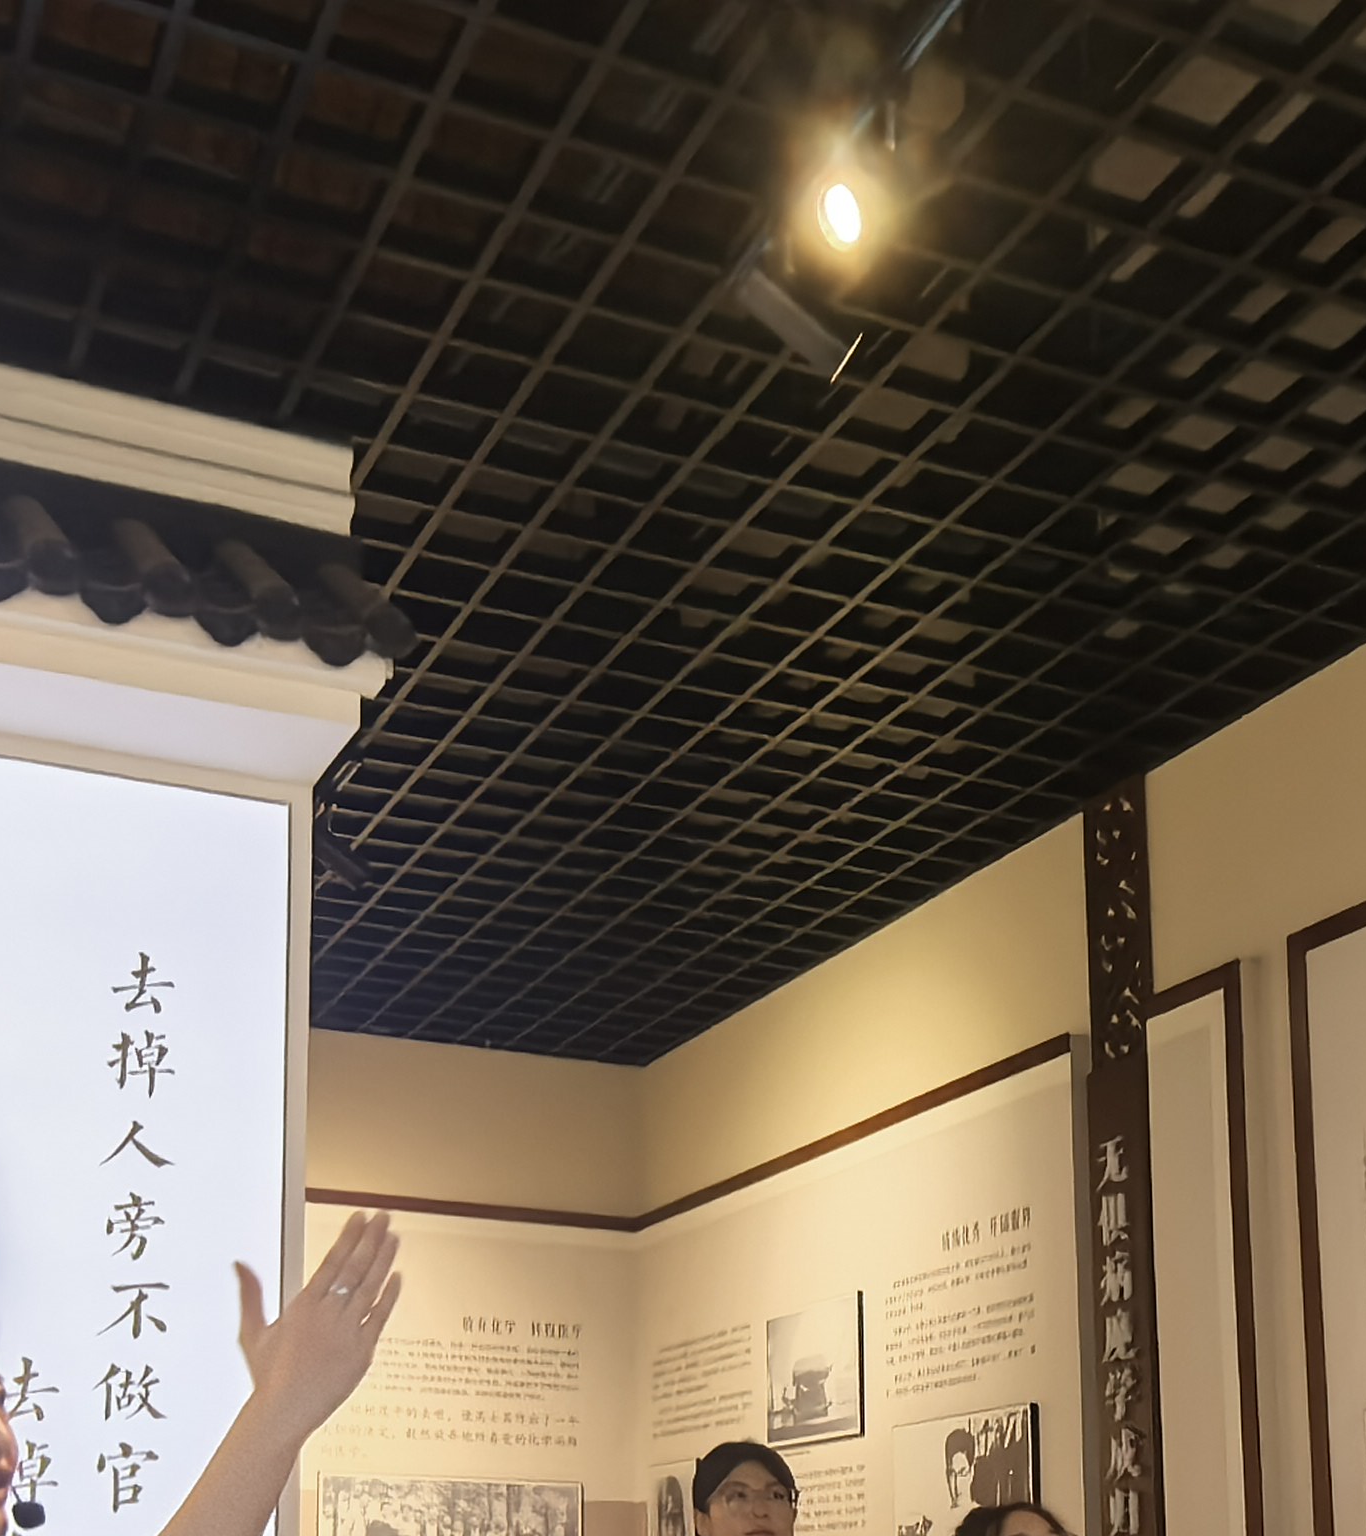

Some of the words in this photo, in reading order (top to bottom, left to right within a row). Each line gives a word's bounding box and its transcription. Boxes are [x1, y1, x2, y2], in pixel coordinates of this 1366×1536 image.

[93, 952, 176, 1513] 去掉人旁不做官
